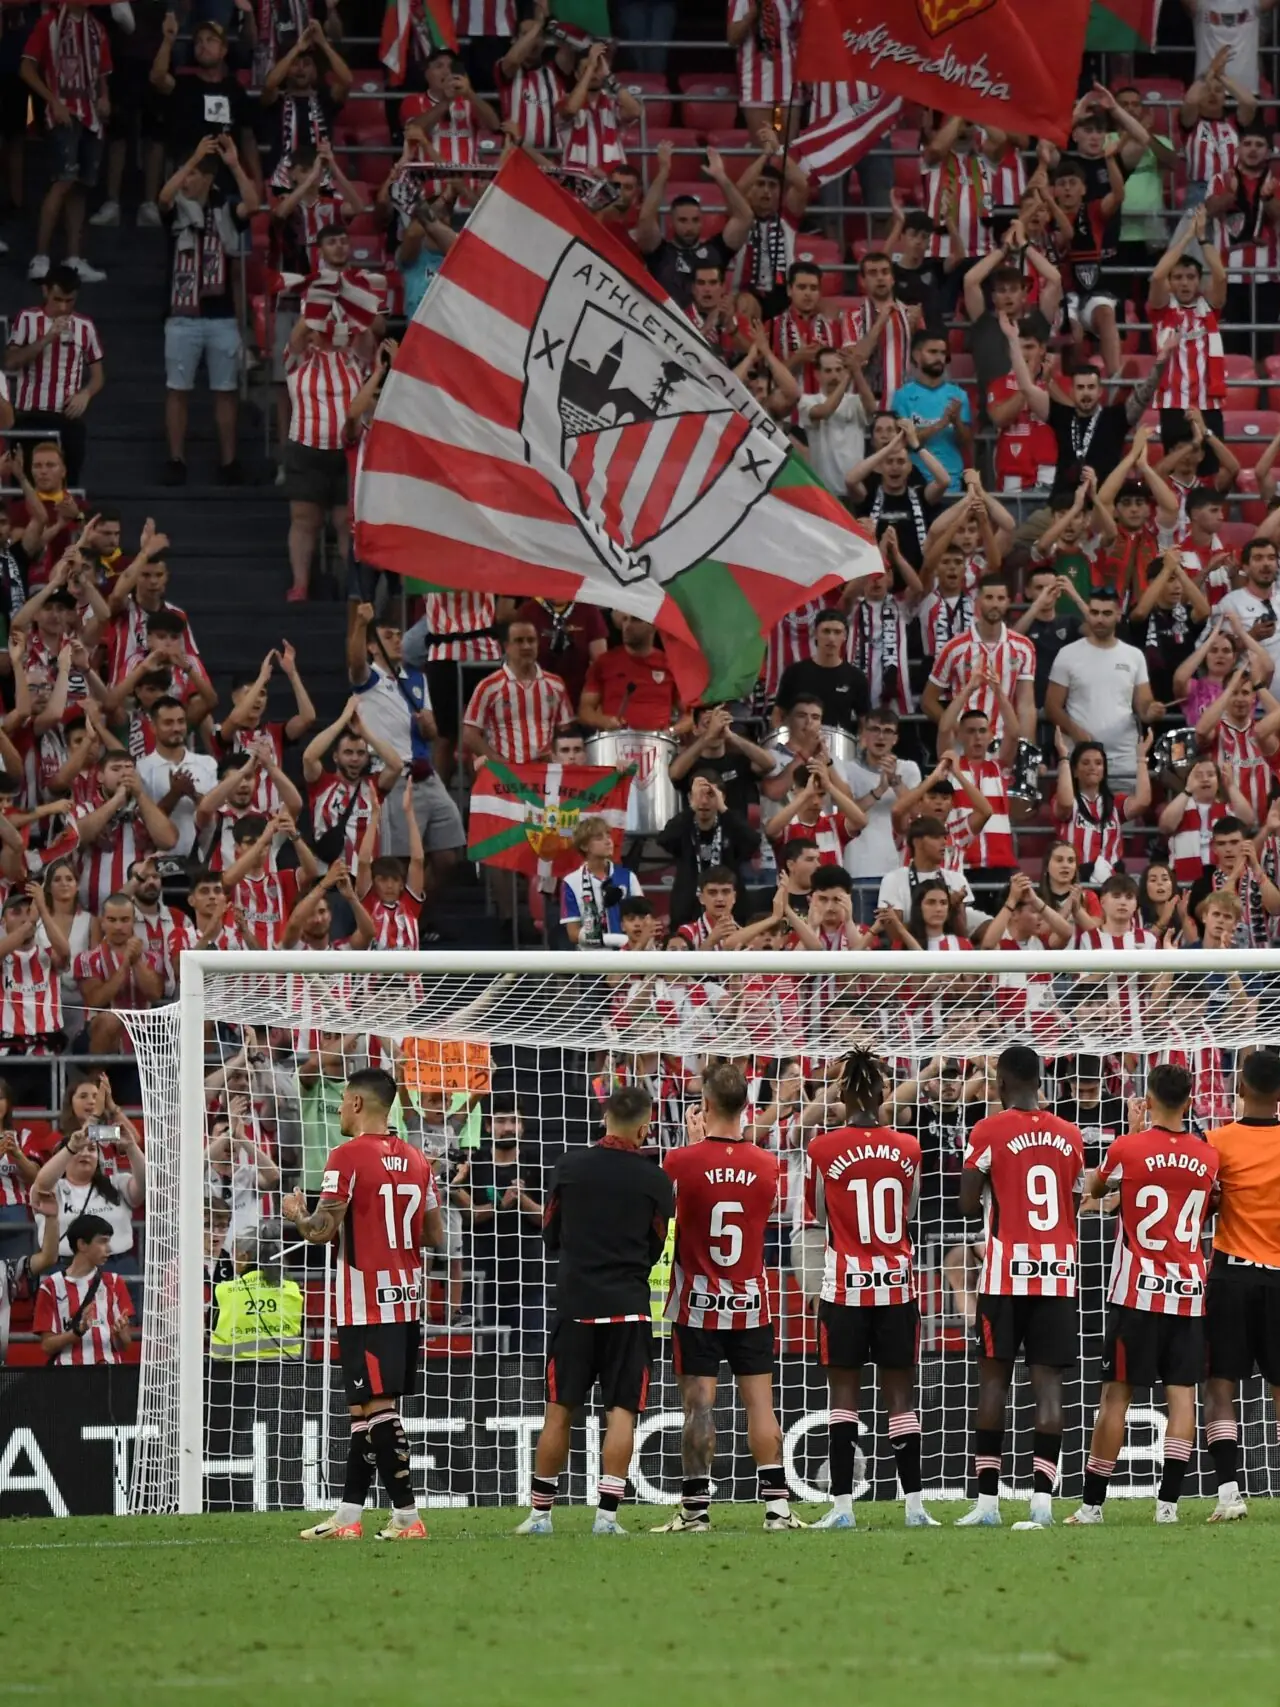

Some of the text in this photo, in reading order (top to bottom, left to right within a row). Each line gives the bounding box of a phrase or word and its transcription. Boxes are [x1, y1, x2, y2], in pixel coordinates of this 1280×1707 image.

[572, 263, 702, 366] ATHLETIC
[493, 782, 552, 796] EUSKAL
[1006, 1131, 1073, 1157] WILLIAMS
[827, 1143, 915, 1181] WILLIAMS JR
[1144, 1152, 1208, 1178] PRADOS
[704, 1167, 757, 1187] YERAY
[846, 1177, 903, 1244] 10
[1026, 1164, 1059, 1232] 9
[378, 1183, 422, 1250] 17
[1135, 1184, 1206, 1253] 24
[709, 1200, 744, 1267] 5
[846, 1271, 910, 1288] DIGI
[1010, 1259, 1076, 1277] DIGI
[1137, 1274, 1204, 1296] DIGI
[243, 1298, 277, 1316] 229
[689, 1291, 760, 1311] DIGI
